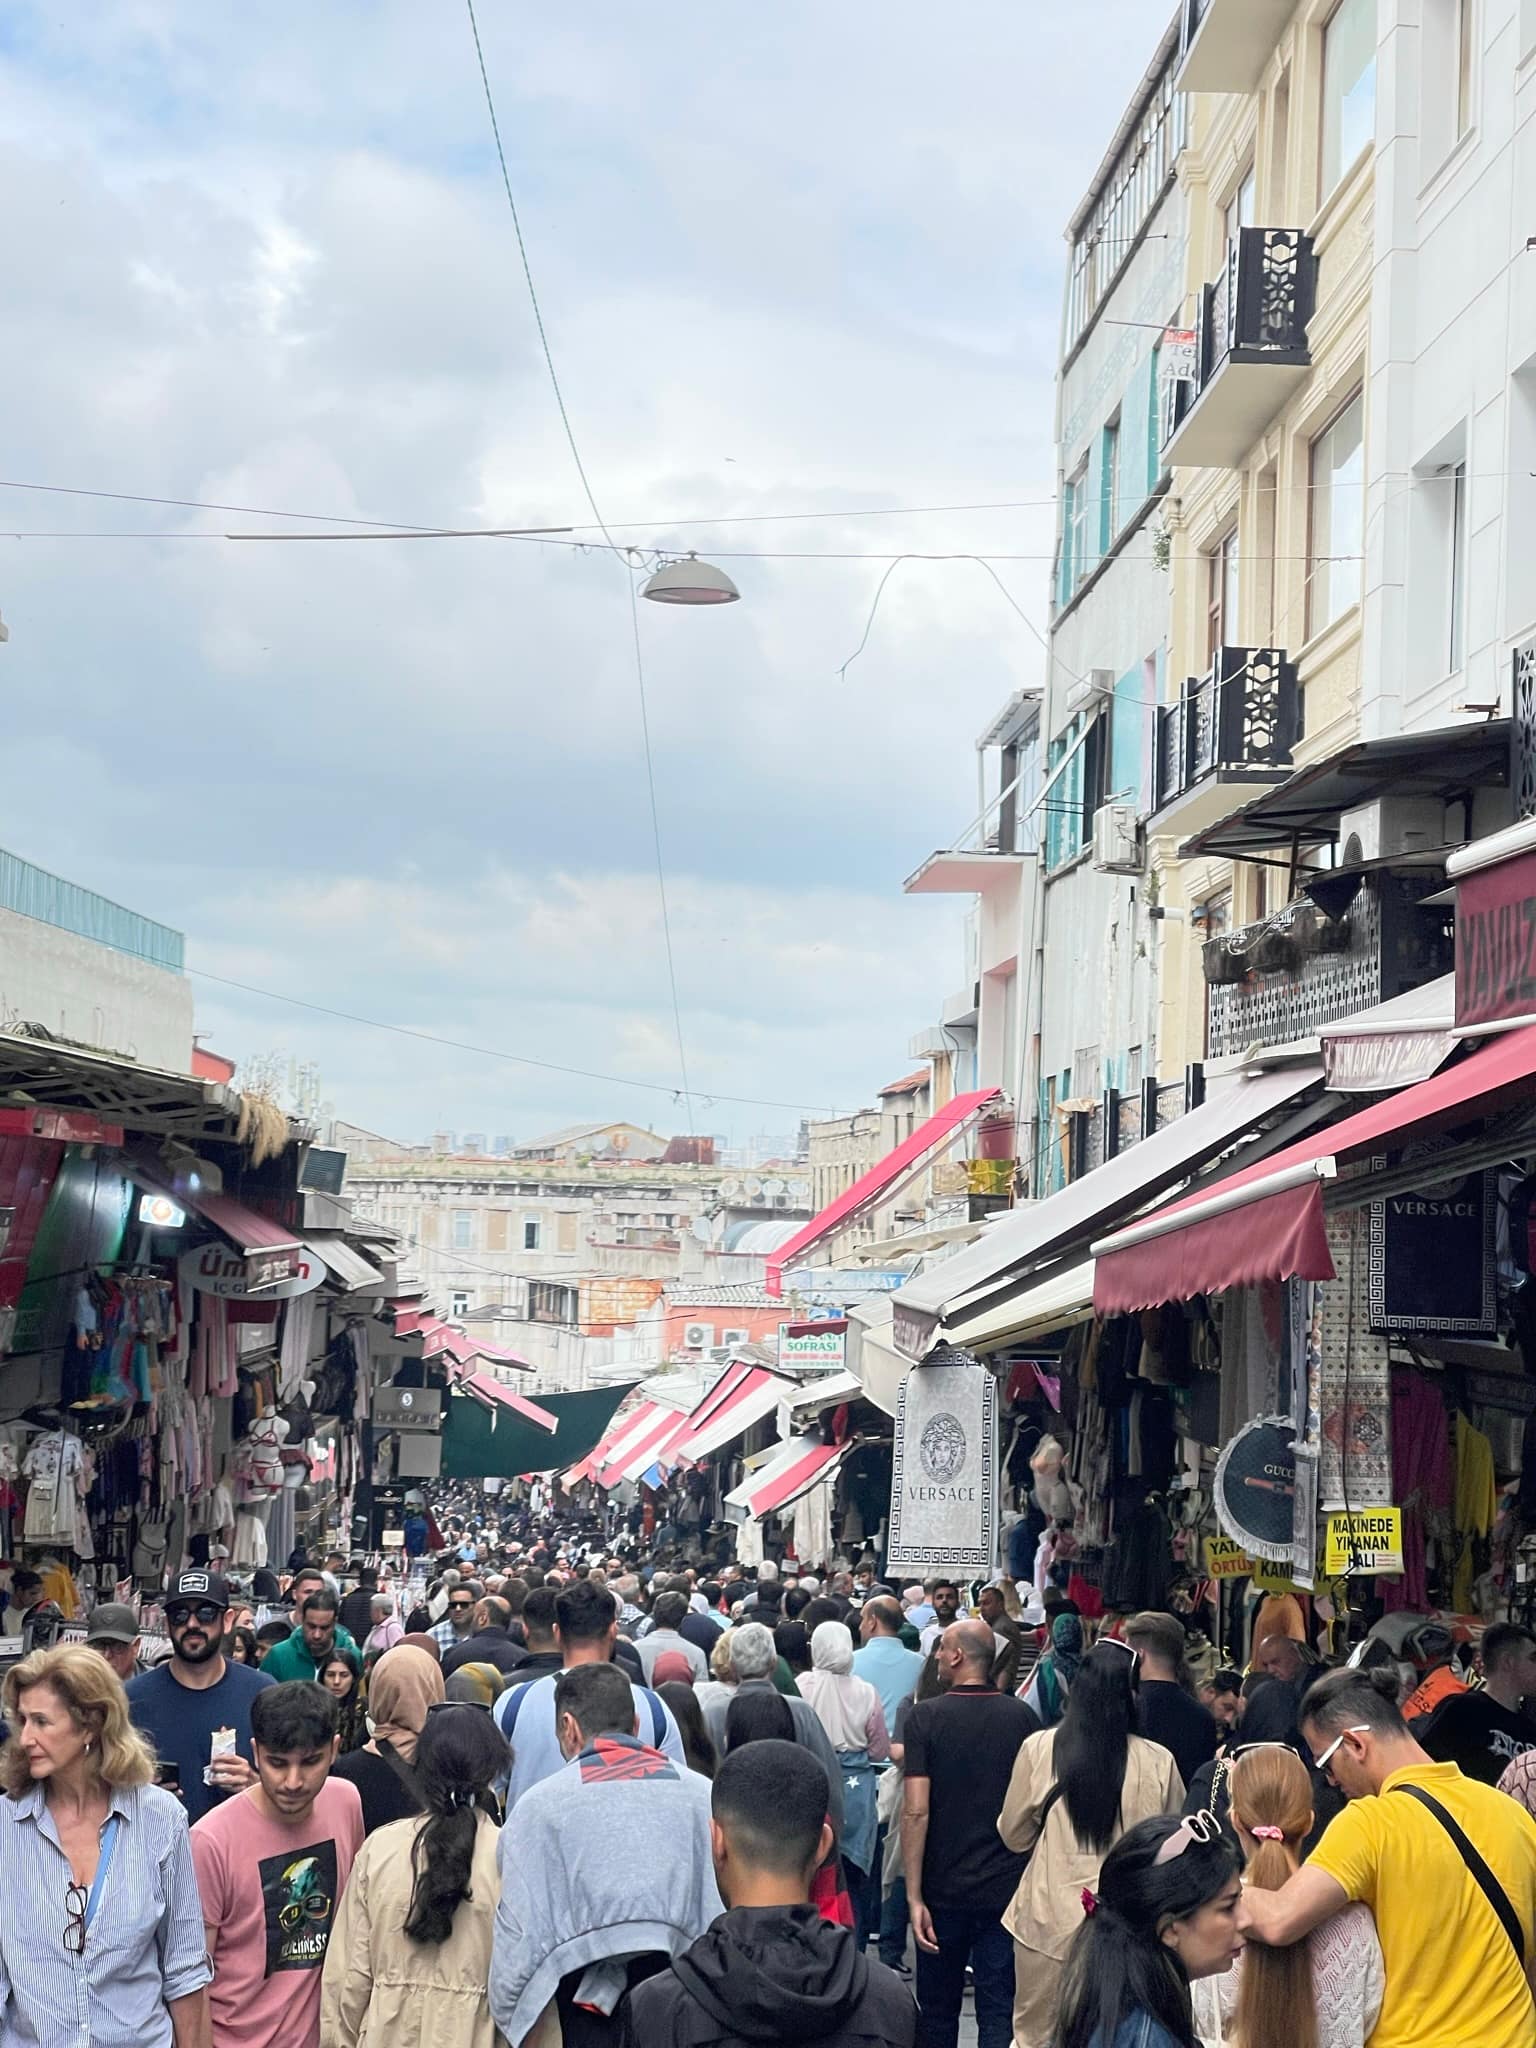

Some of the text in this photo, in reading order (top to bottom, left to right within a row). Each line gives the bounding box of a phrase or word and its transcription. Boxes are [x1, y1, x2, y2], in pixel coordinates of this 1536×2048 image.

[1393, 1201, 1476, 1216] VERSACE
[1263, 1464, 1296, 1479] GUCC
[909, 1487, 976, 1501] VERSACE
[1336, 1535, 1390, 1551] YIKANAN
[1348, 1553, 1376, 1568] HALI
